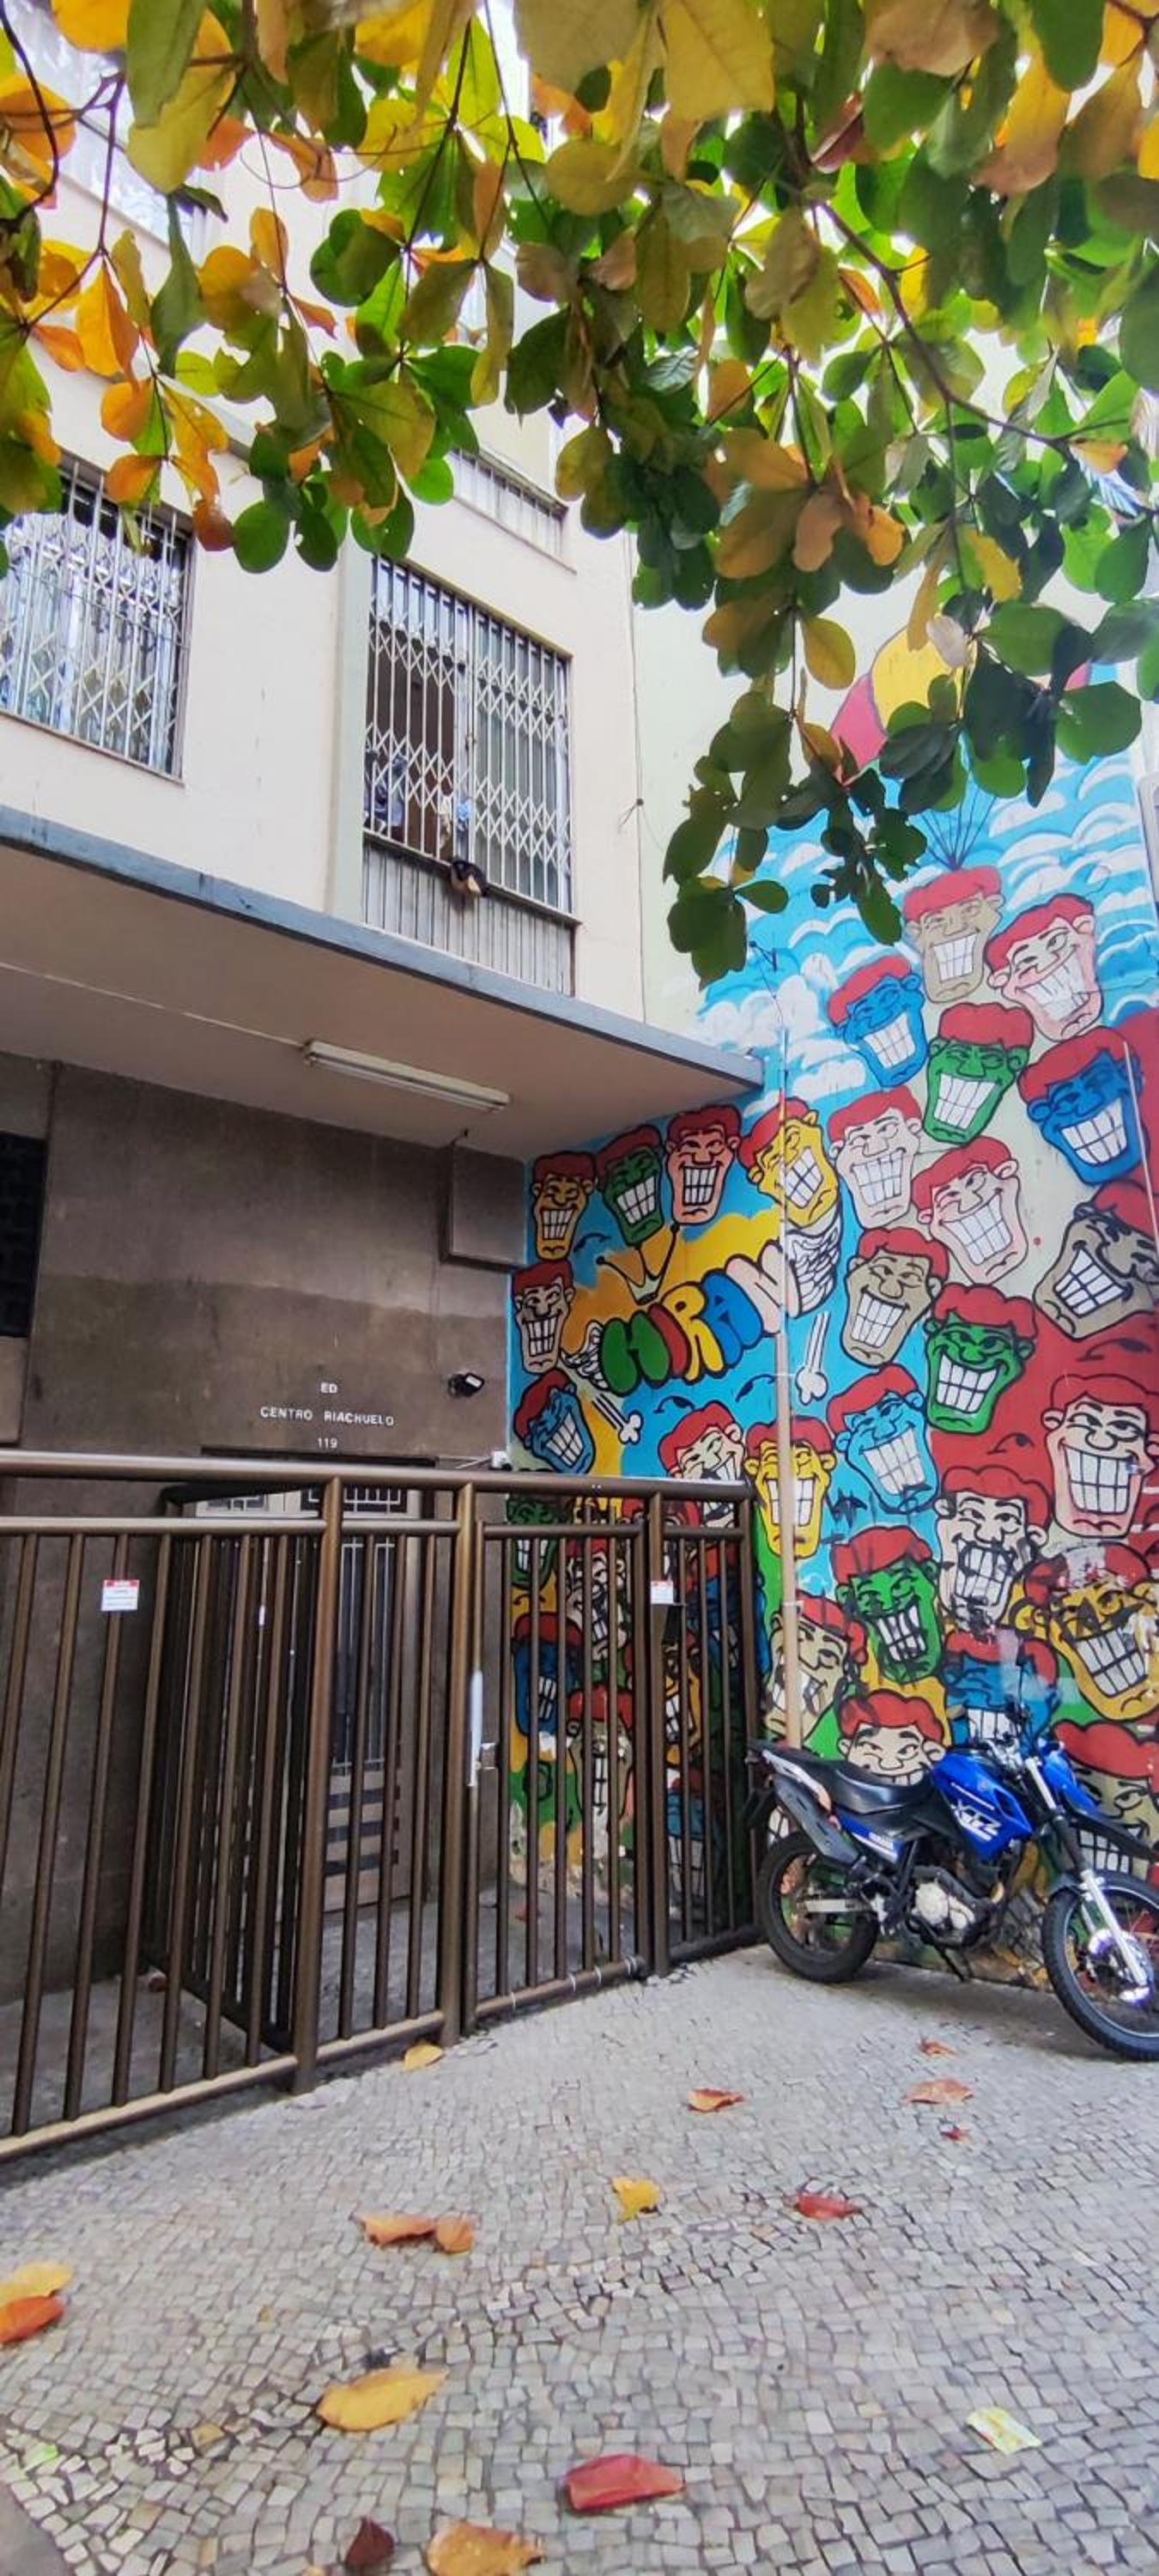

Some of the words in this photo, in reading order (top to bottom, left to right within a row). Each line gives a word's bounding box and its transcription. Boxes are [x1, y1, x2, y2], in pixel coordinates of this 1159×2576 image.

[600, 1239, 802, 1397] HIRAN
[320, 1382, 337, 1394] ED
[260, 1406, 313, 1421] CENTRO
[324, 1410, 394, 1426] RIACHUELO
[317, 1437, 337, 1449] 119
